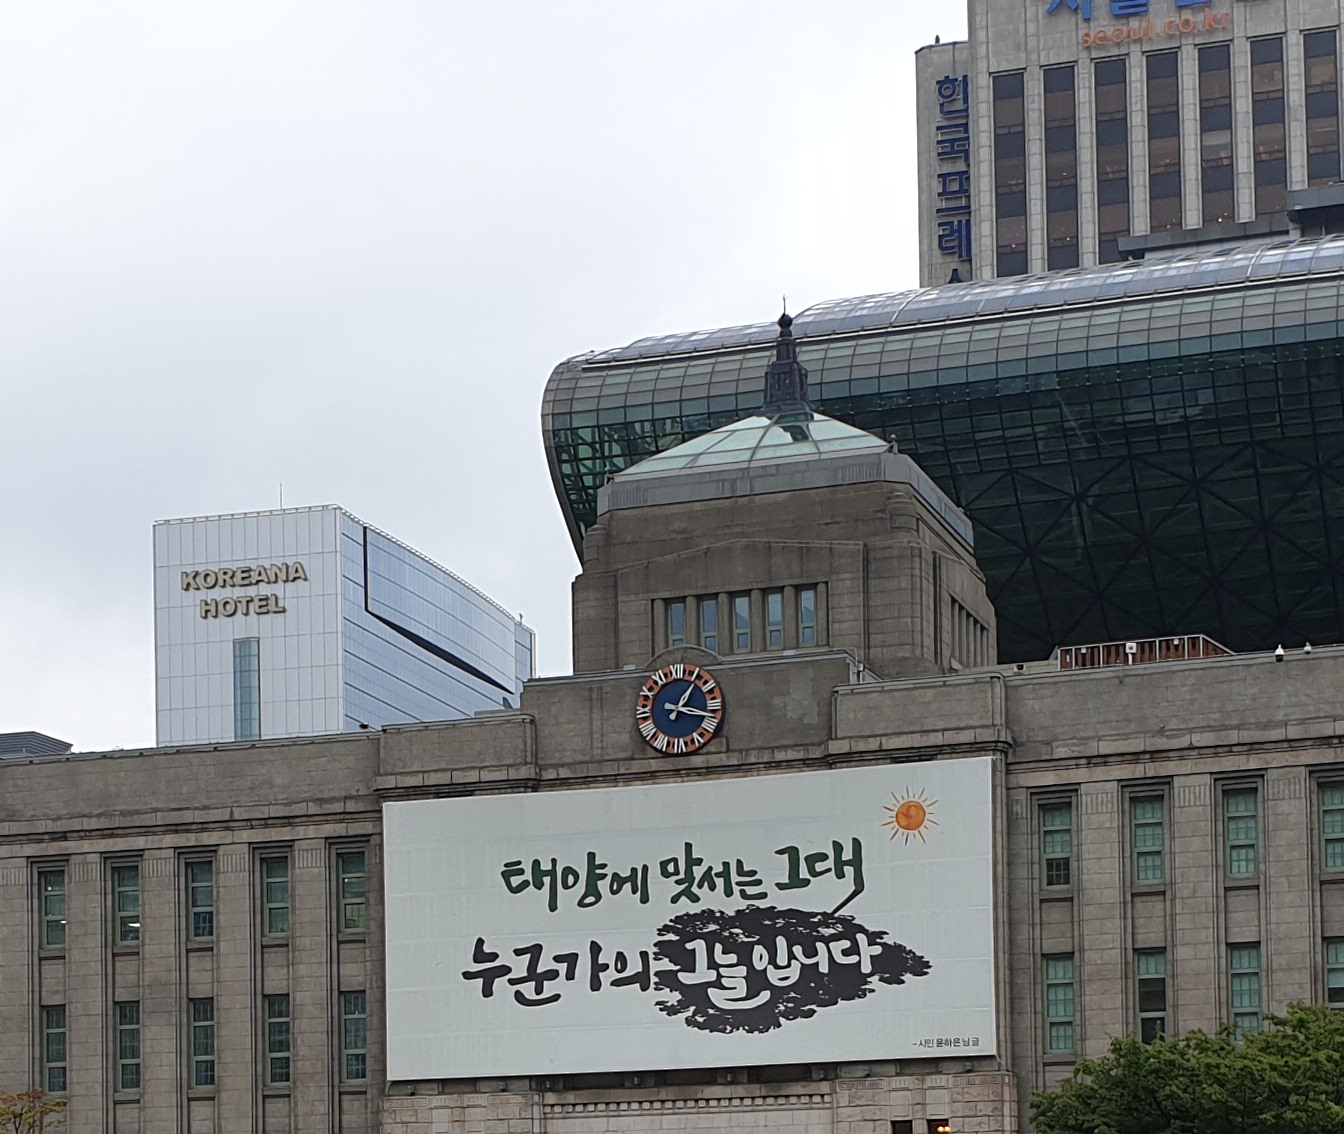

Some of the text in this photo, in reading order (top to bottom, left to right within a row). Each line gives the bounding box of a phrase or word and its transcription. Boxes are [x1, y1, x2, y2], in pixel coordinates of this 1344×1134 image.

[1081, 7, 1231, 48] seoul.co.kr
[181, 561, 309, 591] KOREANA
[200, 594, 286, 619] HOTEL
[501, 837, 866, 912] 태양에 맞서는 그대
[461, 934, 883, 1010] 누군가의 그늘입니다
